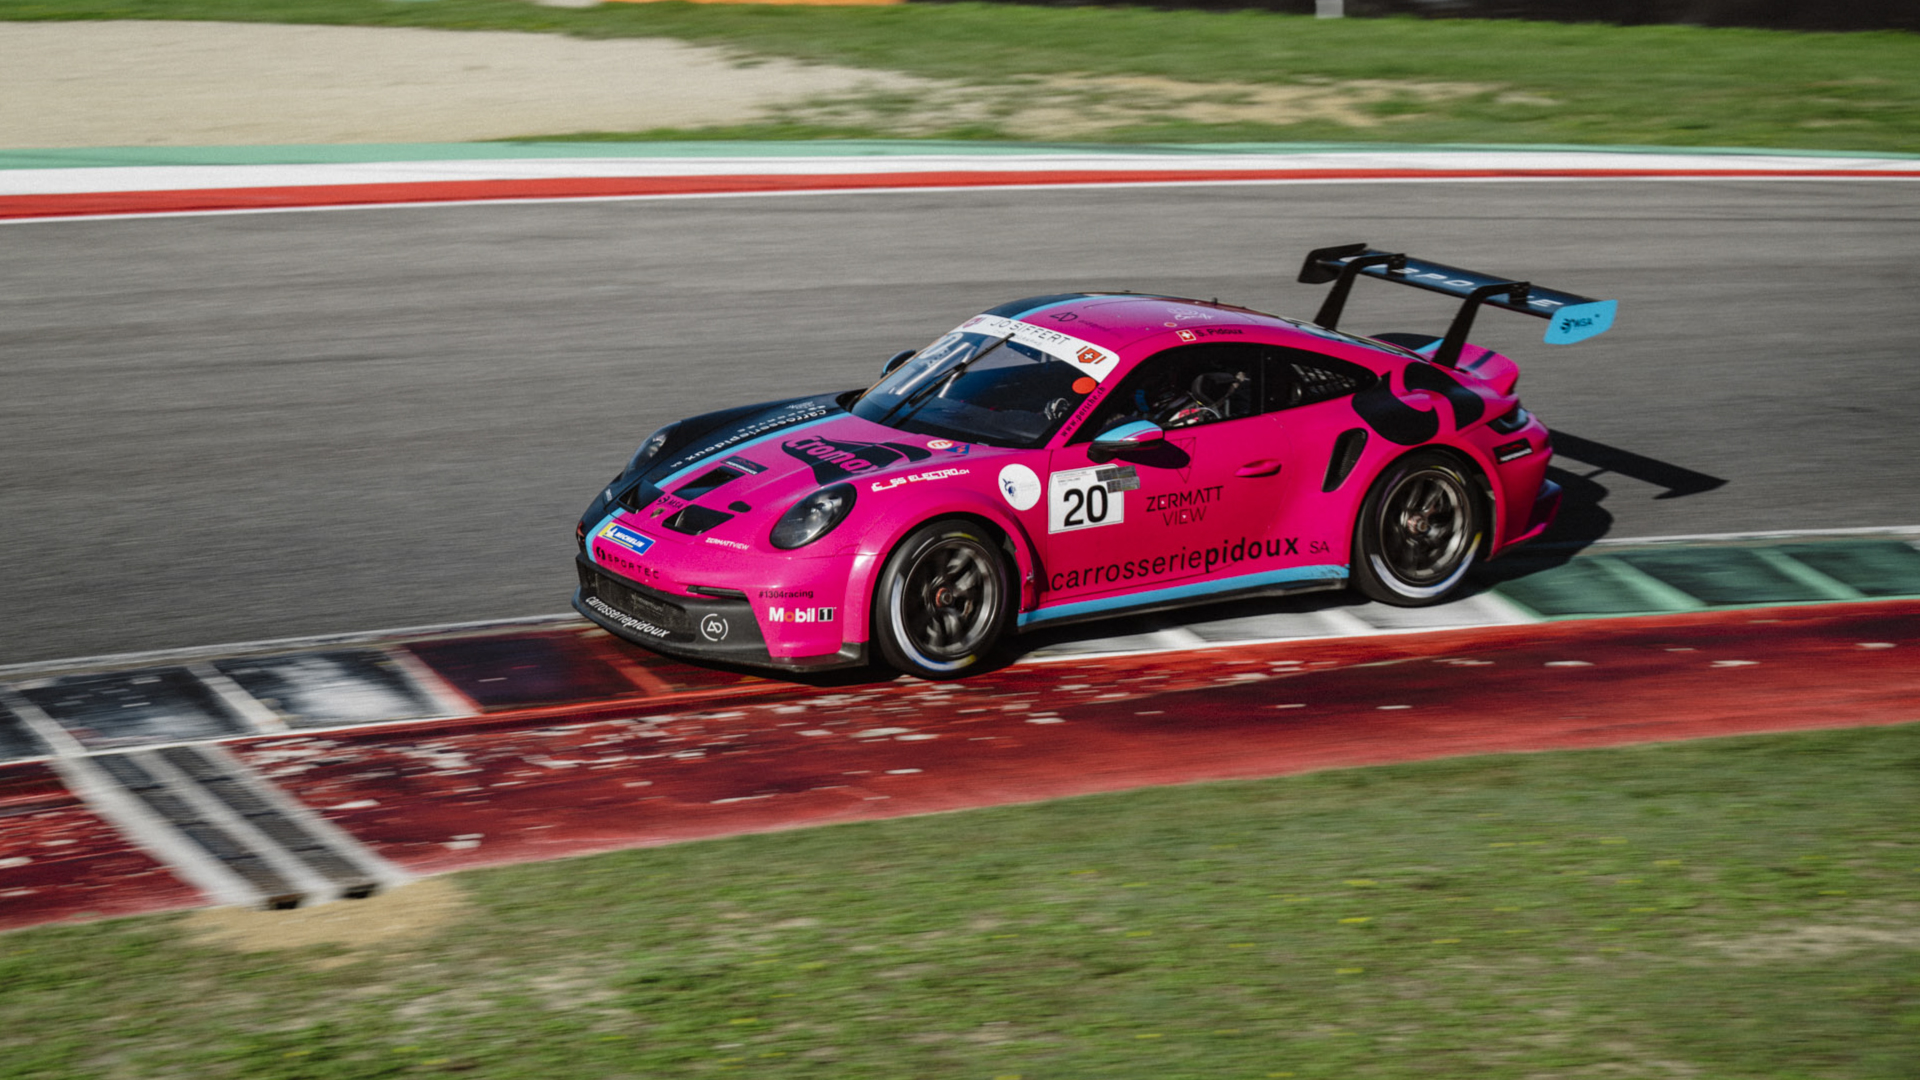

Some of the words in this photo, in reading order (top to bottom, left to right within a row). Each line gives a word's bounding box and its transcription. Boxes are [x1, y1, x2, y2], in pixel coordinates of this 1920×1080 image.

[990, 319, 1012, 329] JO
[1009, 322, 1071, 346] SIFFERT
[1061, 386, 1106, 437] www.porsche.ch
[1063, 484, 1109, 528] 20
[1146, 485, 1225, 513] ZERMATT
[1162, 505, 1208, 527] VIEW
[614, 530, 646, 548] MICHELIN
[607, 553, 660, 580] SPORTEC
[1051, 537, 1300, 592] carrosseriepidoux
[1309, 540, 1330, 555] SA
[585, 595, 671, 638] carrosseriepidoux
[769, 606, 816, 623] Mobil
